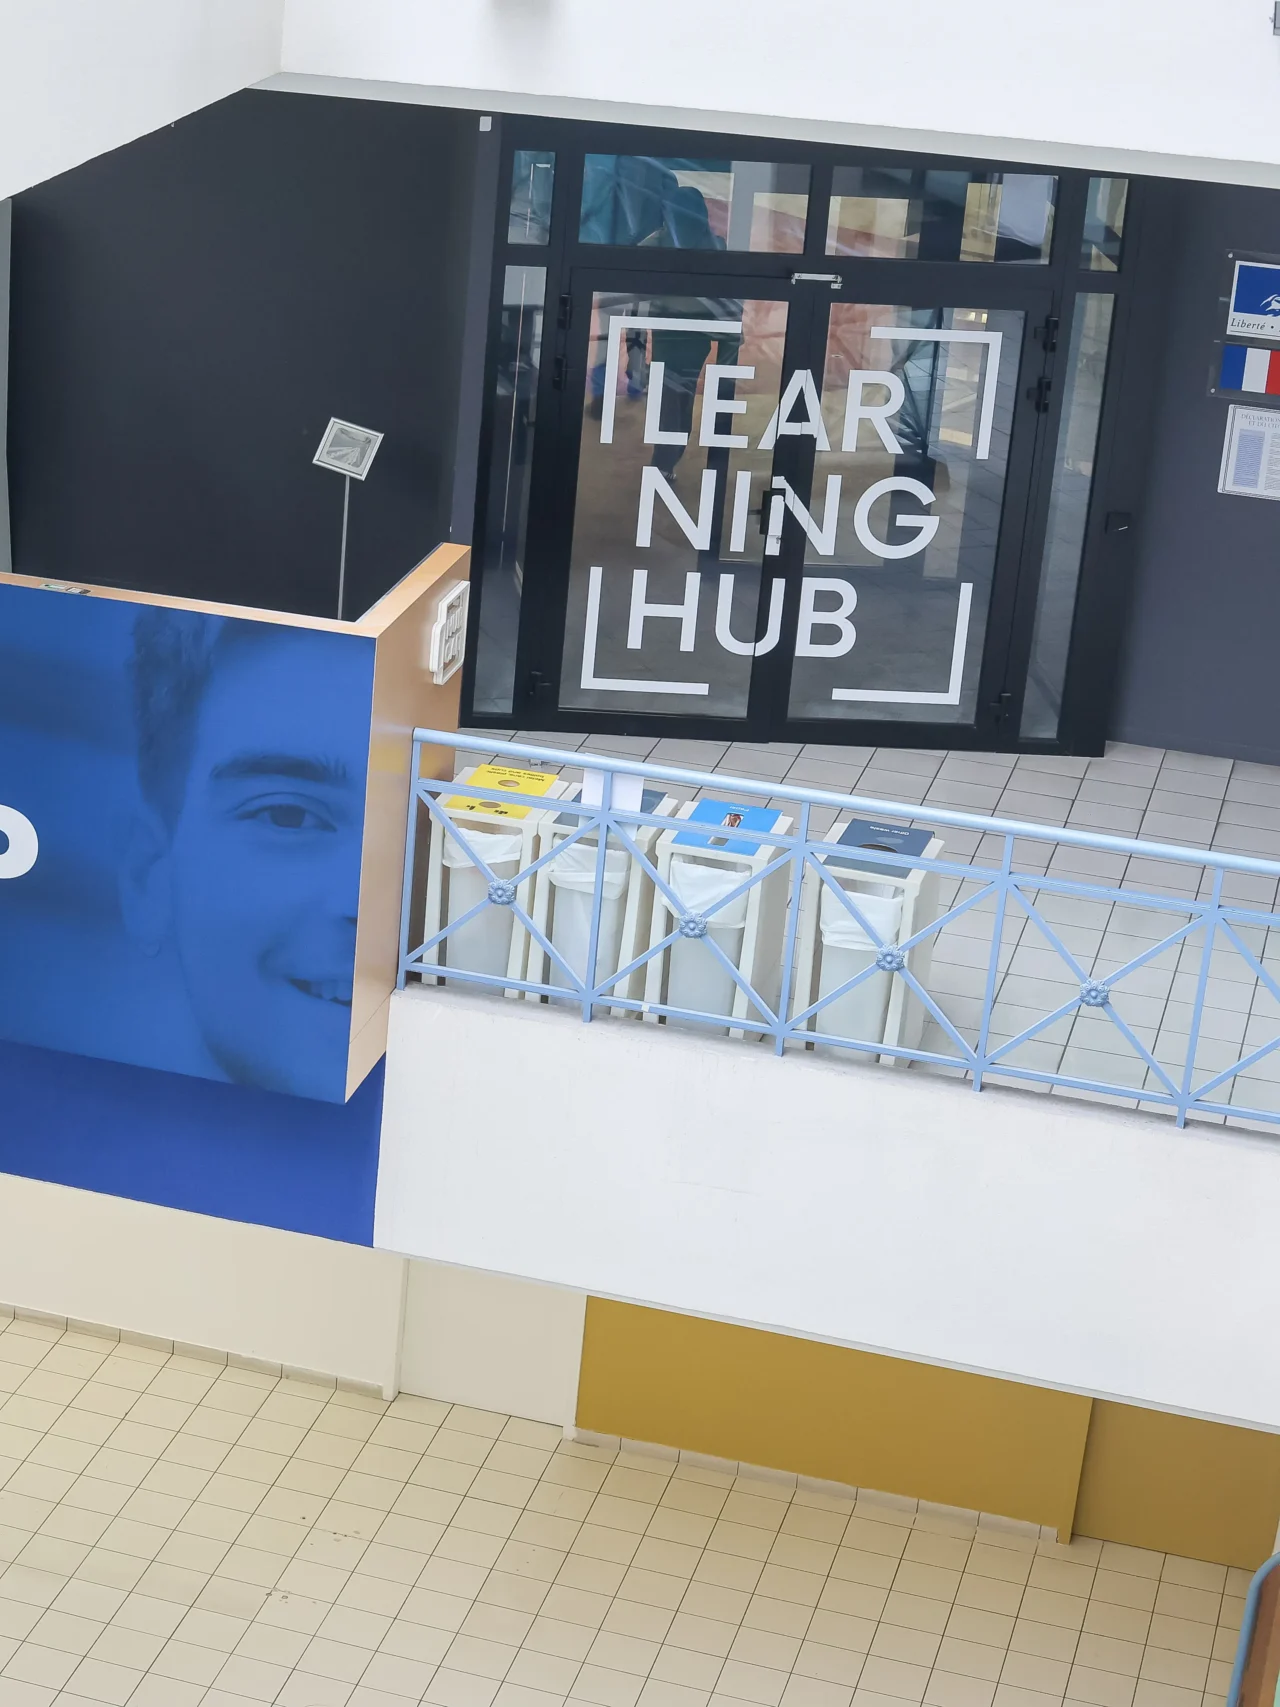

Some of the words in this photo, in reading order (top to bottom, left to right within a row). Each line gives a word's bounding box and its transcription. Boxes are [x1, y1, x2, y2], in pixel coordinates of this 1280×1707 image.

[1230, 318, 1266, 330] Liberté
[643, 361, 906, 454] LEAR
[635, 466, 940, 559] NING
[626, 568, 858, 658] HUB
